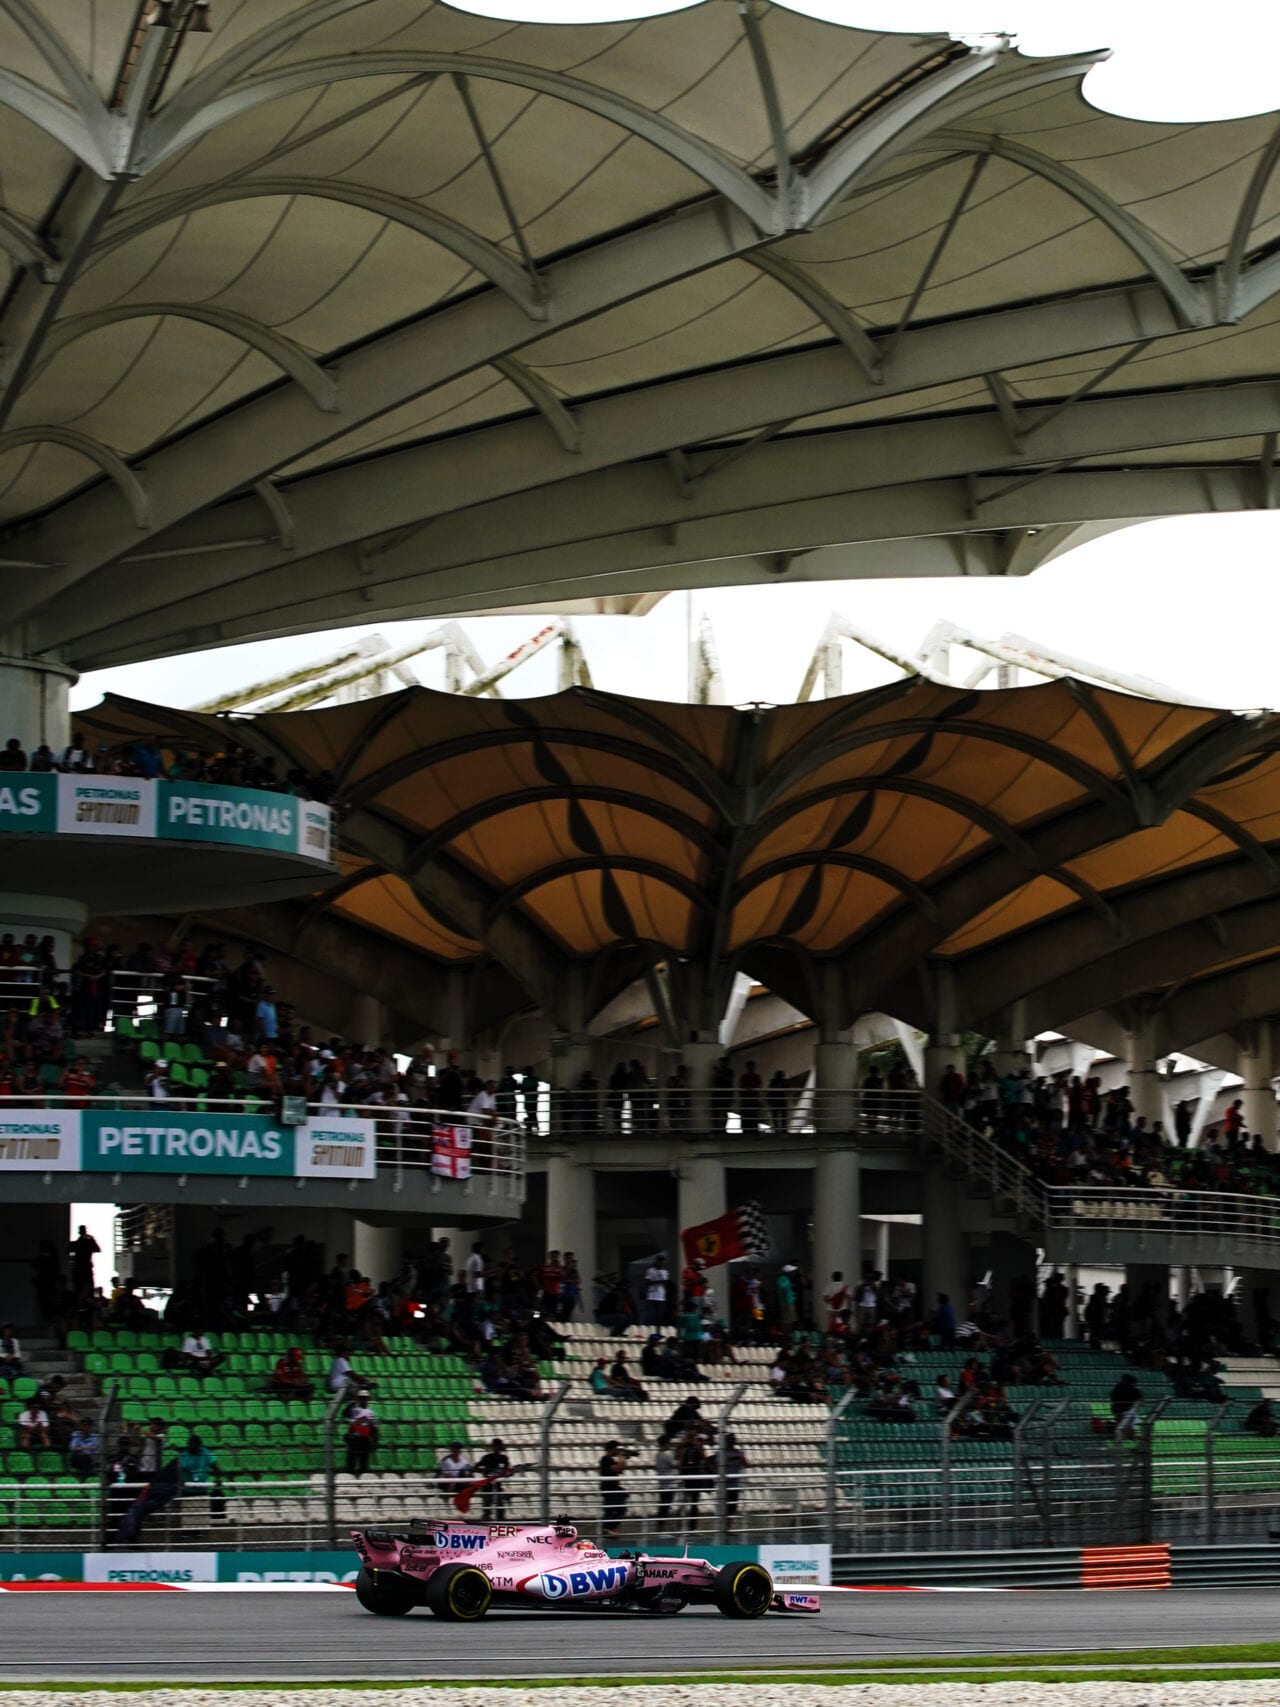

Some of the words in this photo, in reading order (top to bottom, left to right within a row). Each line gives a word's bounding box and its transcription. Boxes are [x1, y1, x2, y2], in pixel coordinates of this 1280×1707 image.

[168, 796, 292, 836] PETRONAS
[98, 1127, 282, 1159] PETRONAS
[489, 1526, 517, 1537] PER
[450, 1535, 487, 1549] BWT
[526, 1536, 553, 1544] NEC
[107, 1570, 193, 1582] PETRONAS
[569, 1566, 627, 1596] BWT
